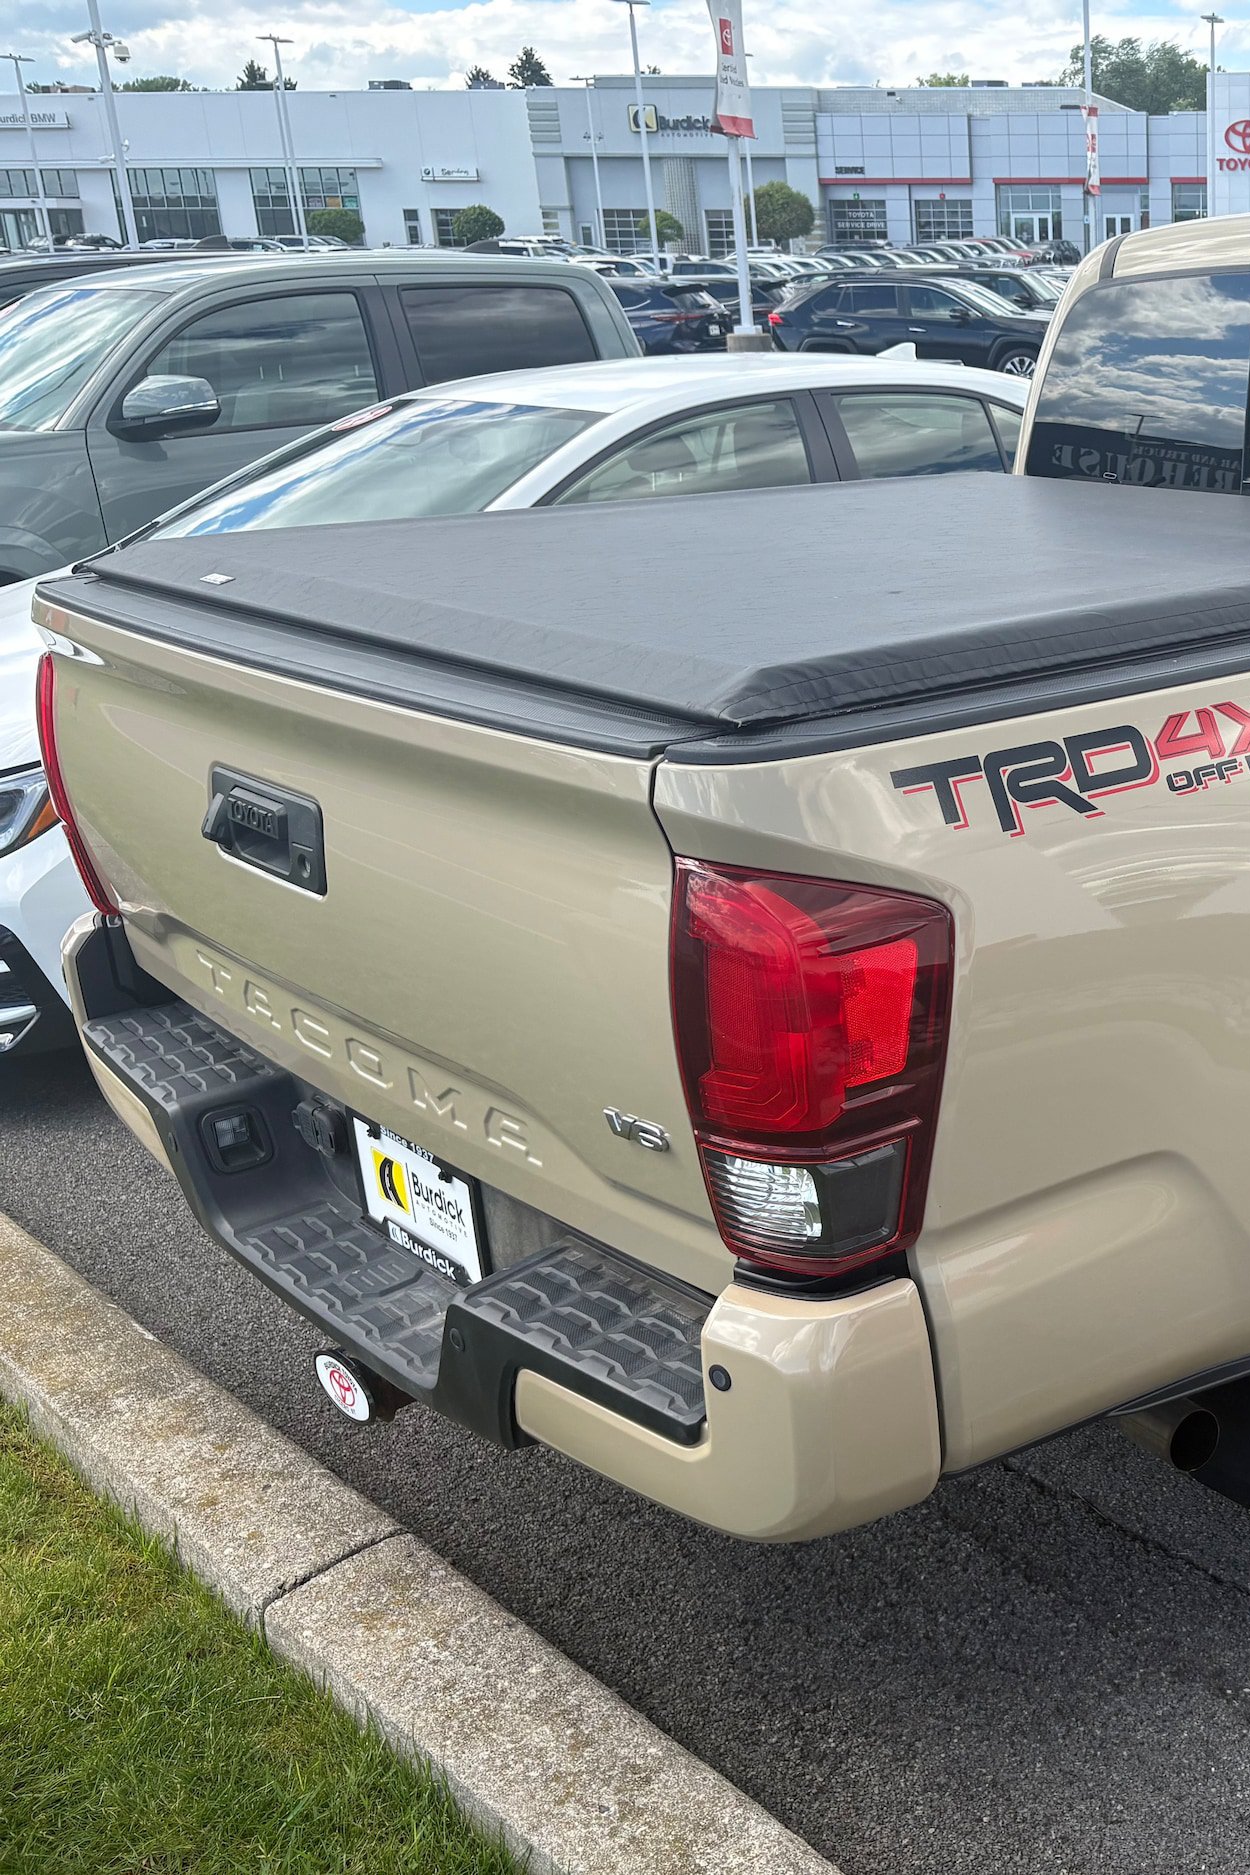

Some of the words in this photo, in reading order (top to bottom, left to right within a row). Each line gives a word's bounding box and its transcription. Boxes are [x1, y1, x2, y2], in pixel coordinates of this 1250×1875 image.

[30, 112, 56, 123] BMW
[658, 115, 711, 131] Burdick
[835, 166, 865, 175] SERVICE
[837, 221, 866, 229] SERVICE
[866, 221, 885, 229] DRIVE
[848, 211, 875, 219] TOYOTA
[889, 724, 1160, 838] TRD
[1166, 758, 1243, 795] OFF
[228, 797, 273, 834] TOYOTA
[196, 949, 543, 1167] TACOMA
[379, 1125, 408, 1149] Since
[409, 1143, 435, 1163] 1937
[602, 1106, 669, 1152] V6
[411, 1171, 466, 1227] Burdick
[416, 1200, 469, 1238] AUTOMOTIVE
[429, 1217, 446, 1236] Since
[400, 1230, 457, 1281] Burdick
